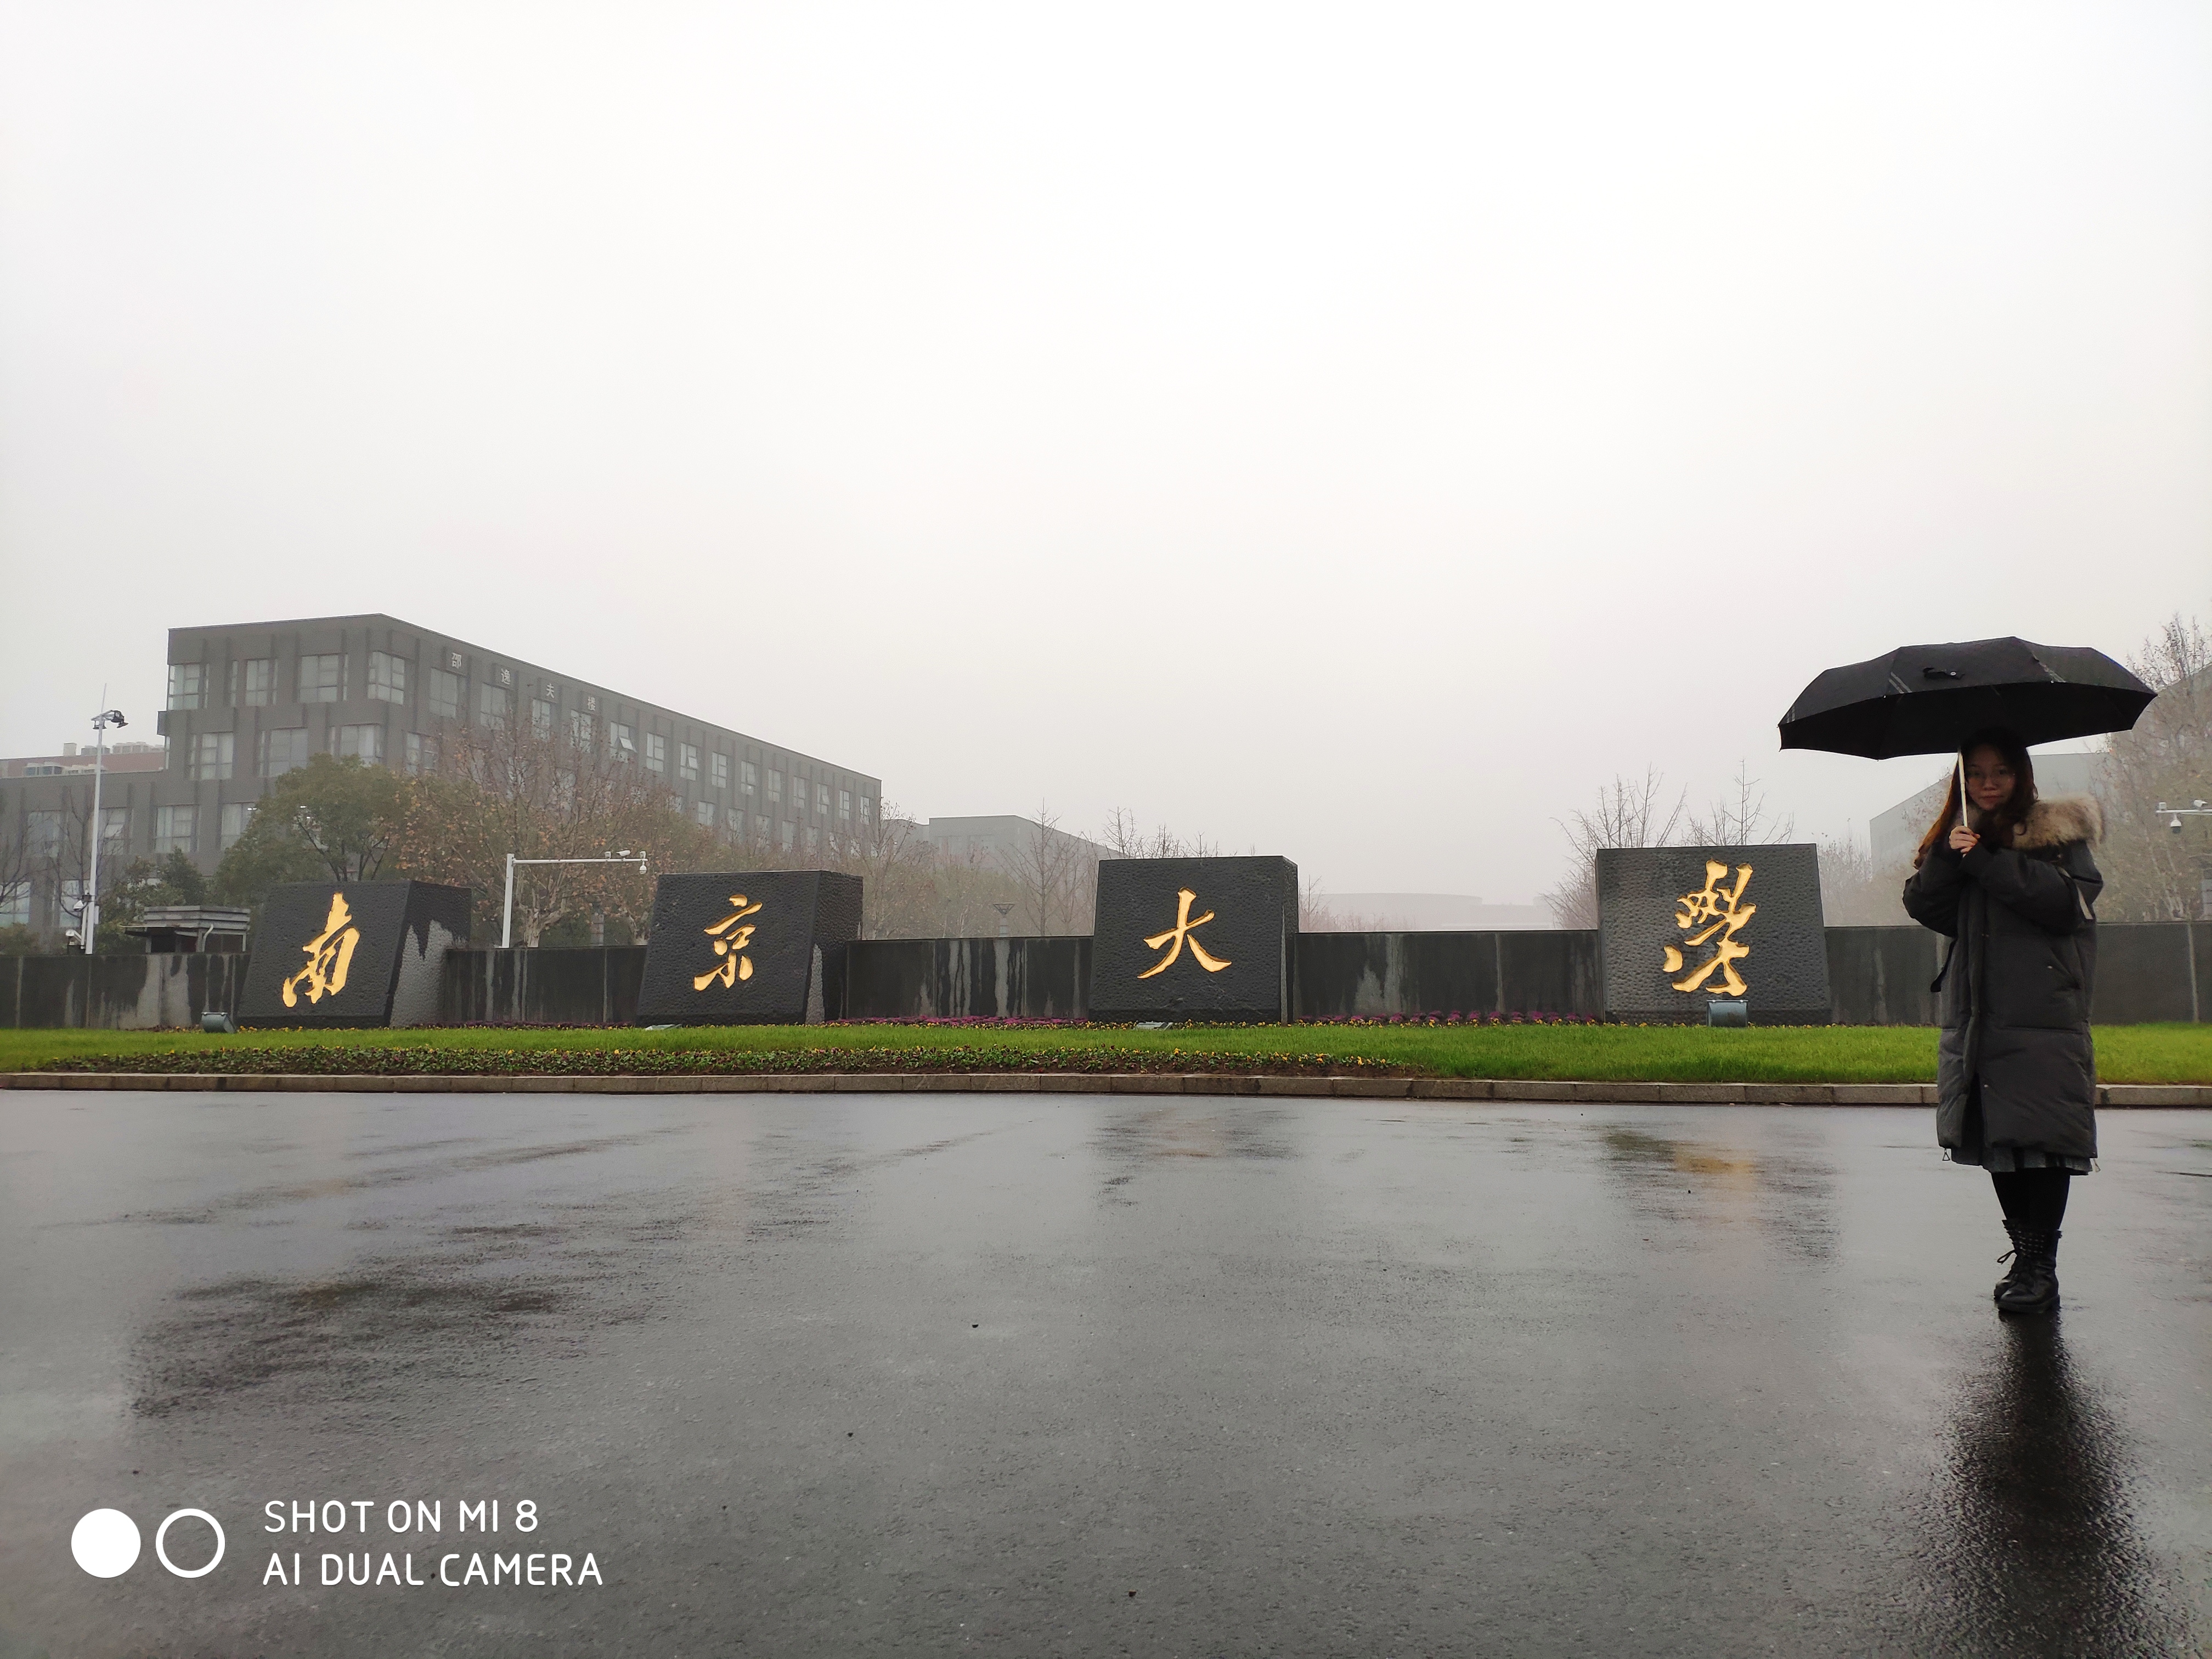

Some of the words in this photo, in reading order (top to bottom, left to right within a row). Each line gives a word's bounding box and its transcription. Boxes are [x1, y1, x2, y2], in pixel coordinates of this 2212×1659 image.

[282, 891, 360, 1008] 南
[693, 894, 763, 992] 京
[1137, 887, 1232, 979] 大
